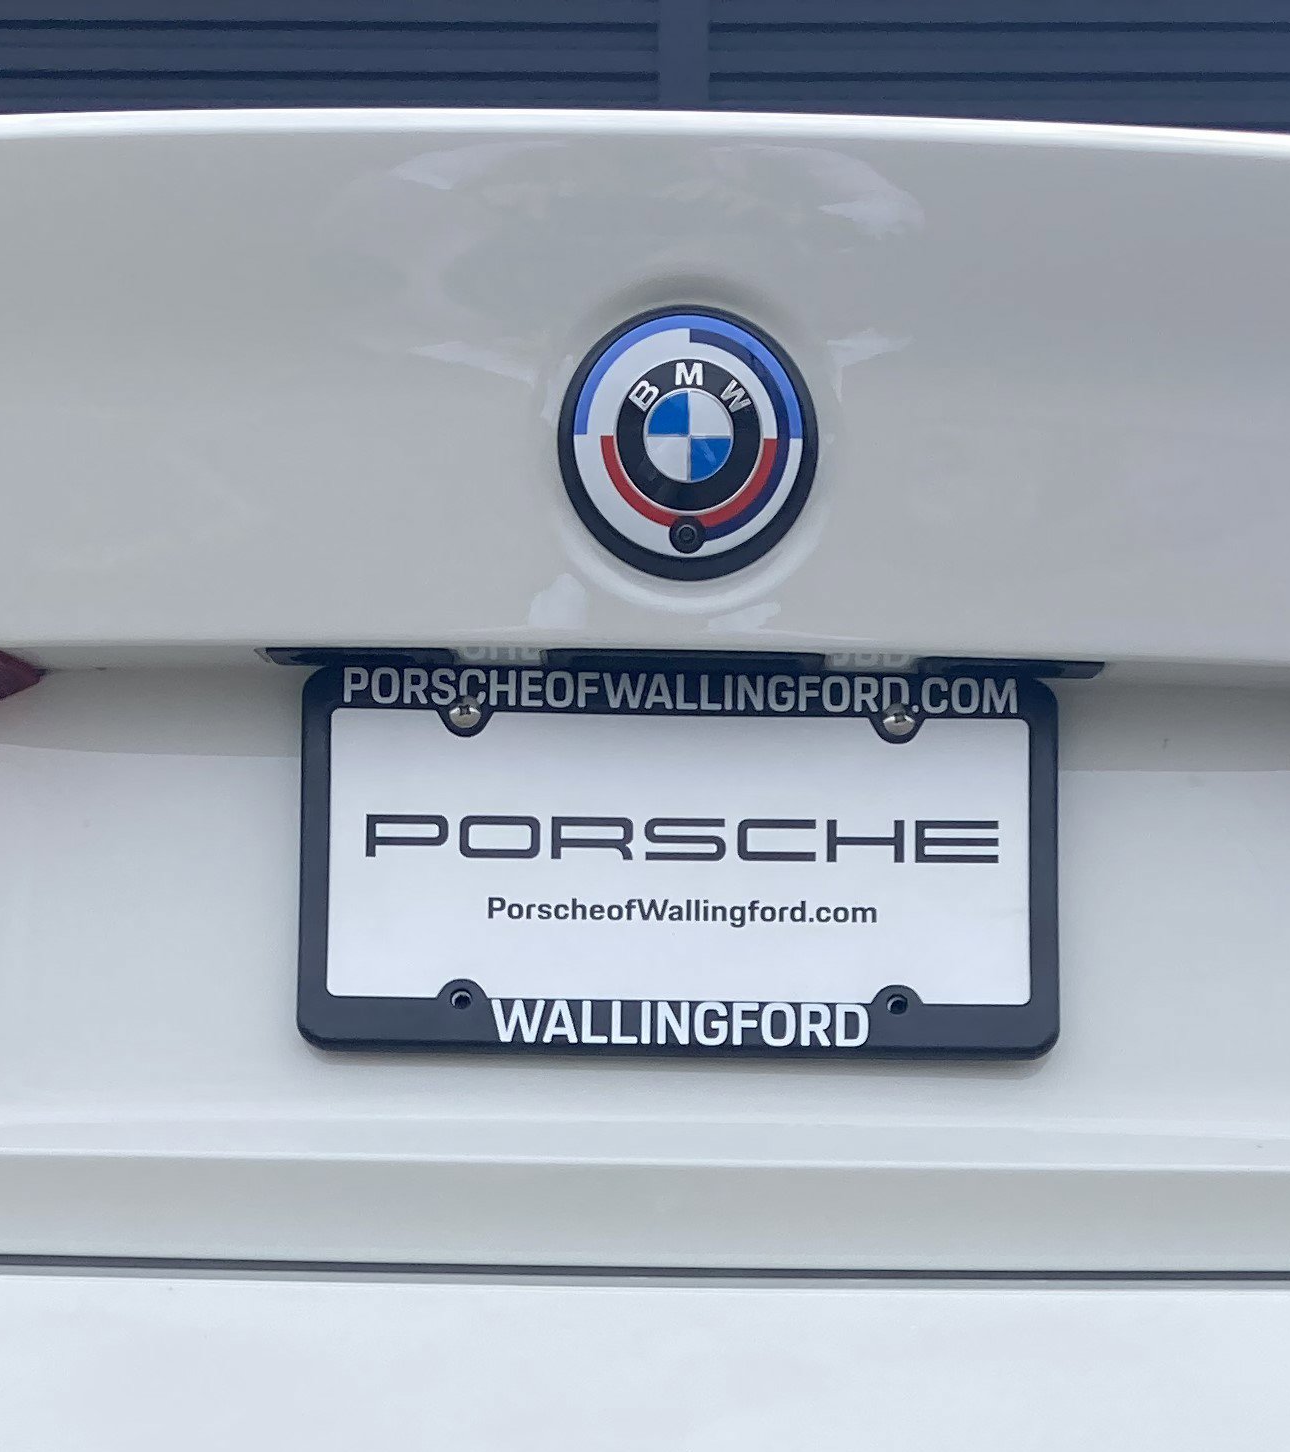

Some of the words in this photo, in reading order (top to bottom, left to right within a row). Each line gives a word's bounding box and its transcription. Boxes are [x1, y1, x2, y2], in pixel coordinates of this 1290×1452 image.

[628, 361, 752, 413] BMW
[341, 666, 1019, 716] PORSCHEOFWALLINGFORD.COM
[365, 813, 1000, 865] PORSCHE
[486, 896, 879, 929] PorscheofWallingford.com
[491, 998, 872, 1048] WALLINGFORD
